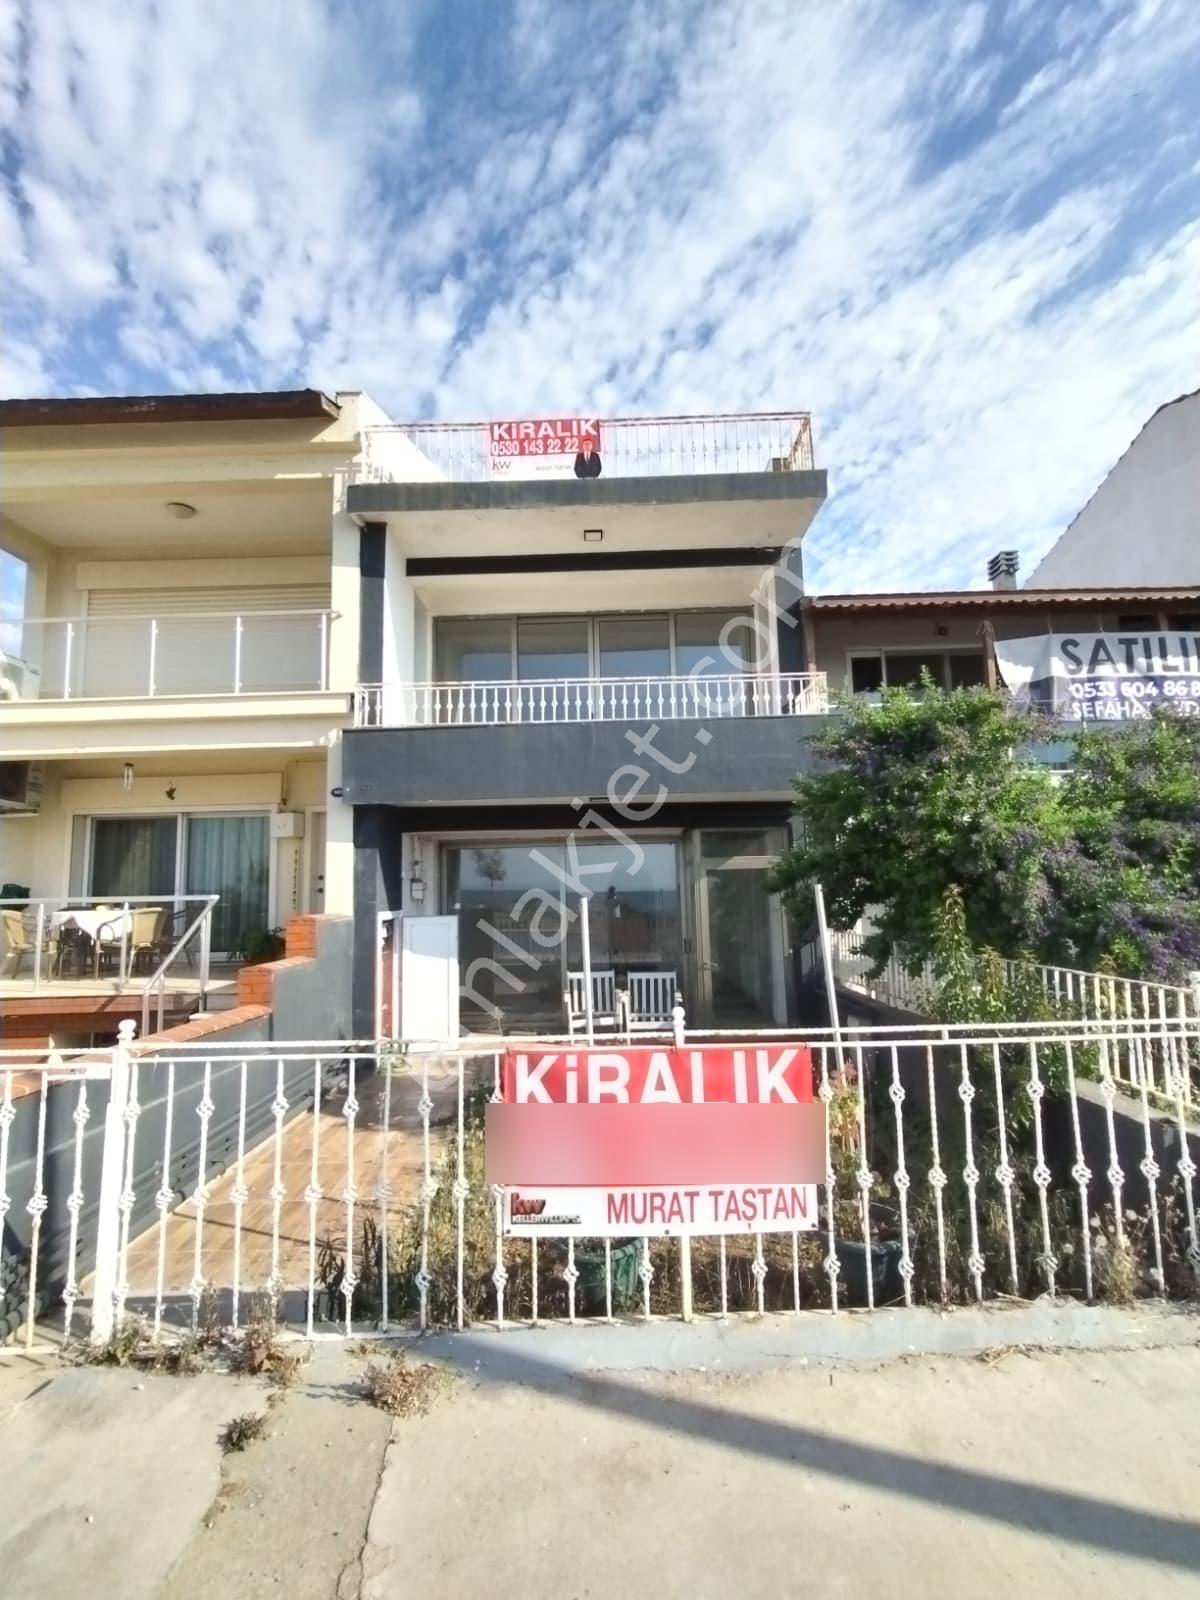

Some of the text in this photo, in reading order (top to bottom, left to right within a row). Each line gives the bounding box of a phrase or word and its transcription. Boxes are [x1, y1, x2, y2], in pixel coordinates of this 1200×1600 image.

[491, 437, 579, 456] 0530 143 22 22
[1120, 681, 1159, 698] 604
[1162, 680, 1189, 697] 86
[607, 1191, 700, 1224] MURAT
